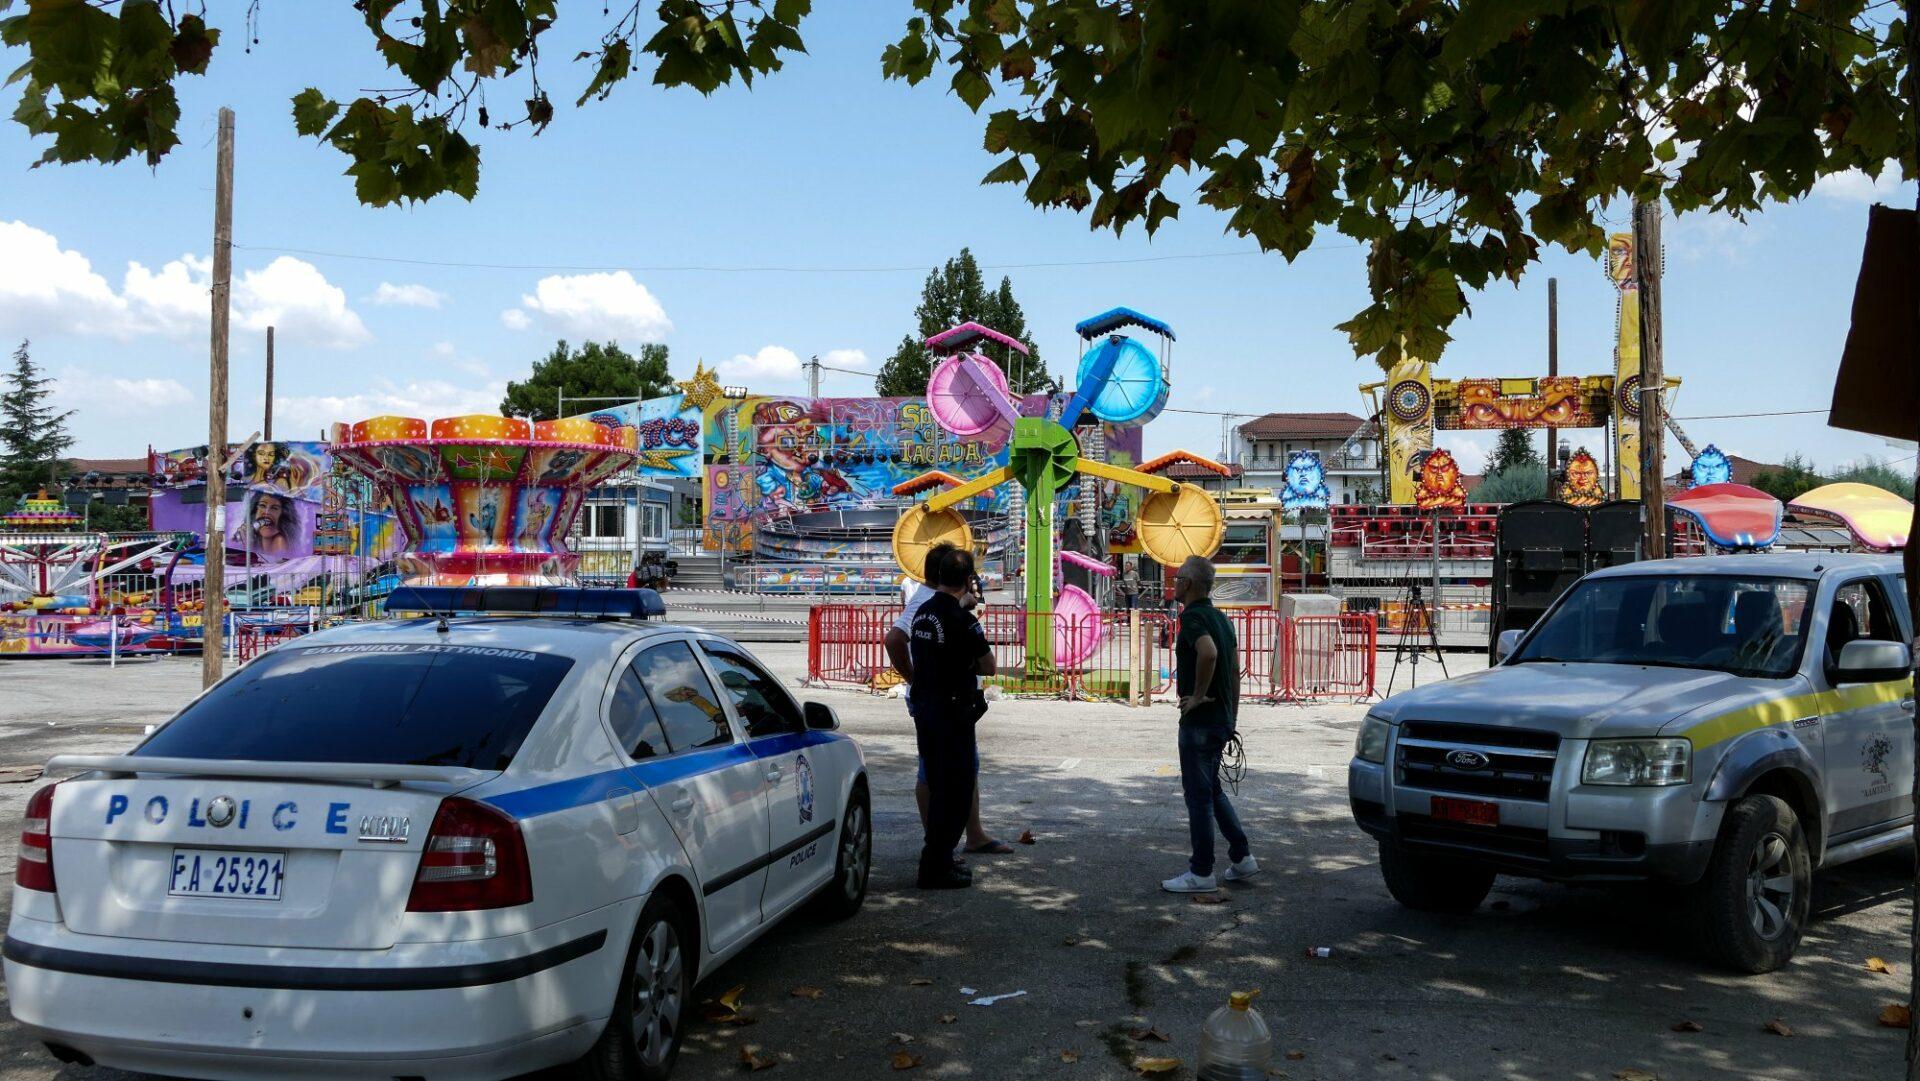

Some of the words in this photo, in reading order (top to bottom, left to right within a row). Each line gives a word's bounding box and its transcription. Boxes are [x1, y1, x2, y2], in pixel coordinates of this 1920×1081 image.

[901, 439, 983, 465] TAGADA
[915, 630, 931, 640] POLICE
[105, 794, 353, 835] POLICE
[789, 843, 817, 869] POLICE
[213, 856, 283, 896] 25321
